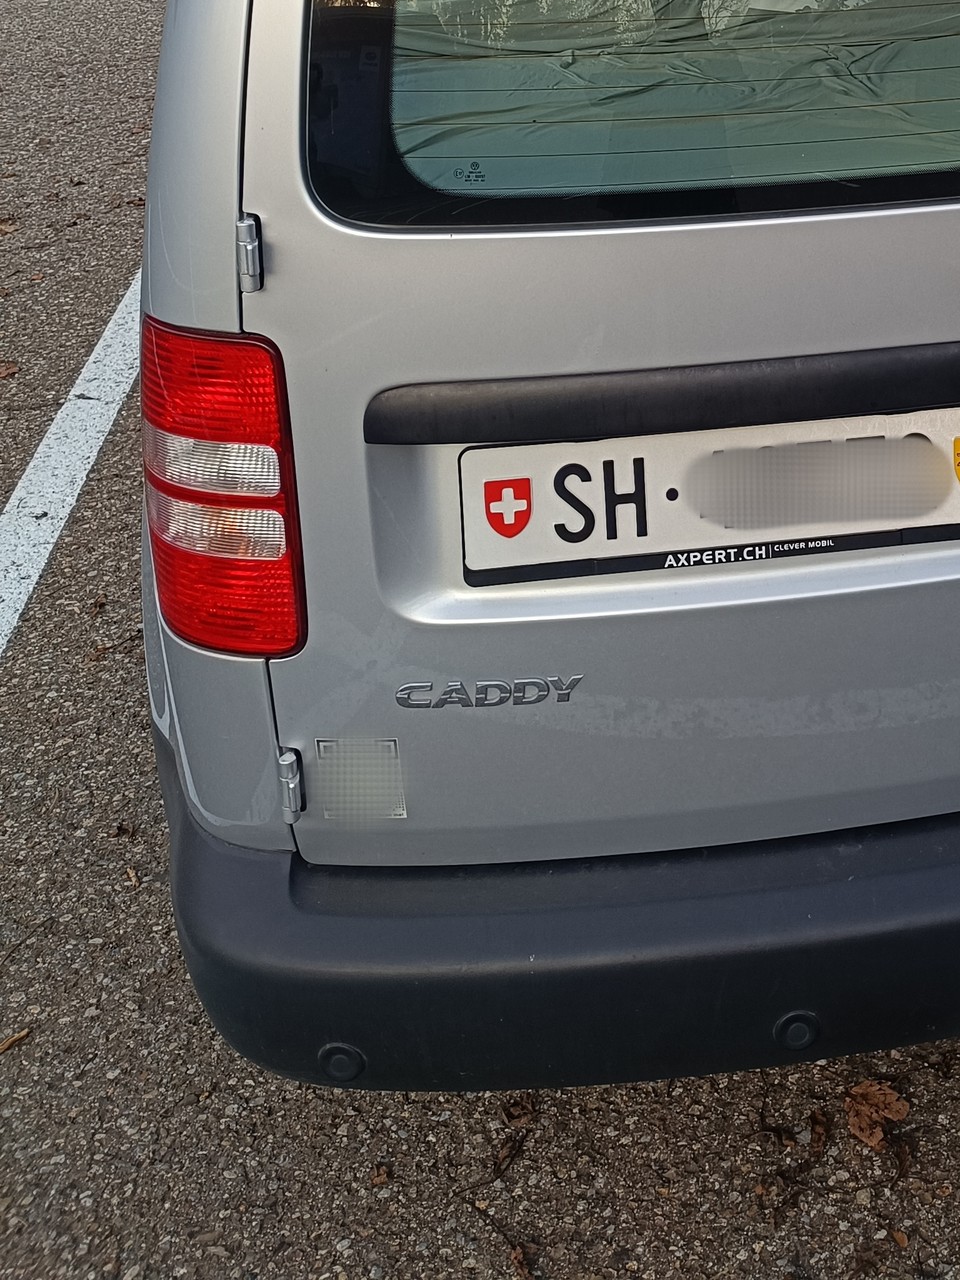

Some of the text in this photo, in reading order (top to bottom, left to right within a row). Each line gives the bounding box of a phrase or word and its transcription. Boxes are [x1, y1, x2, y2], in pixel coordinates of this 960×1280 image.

[664, 539, 835, 568] AXPERT.CH CLEVER MOBIL
[395, 673, 585, 708] CADDY
